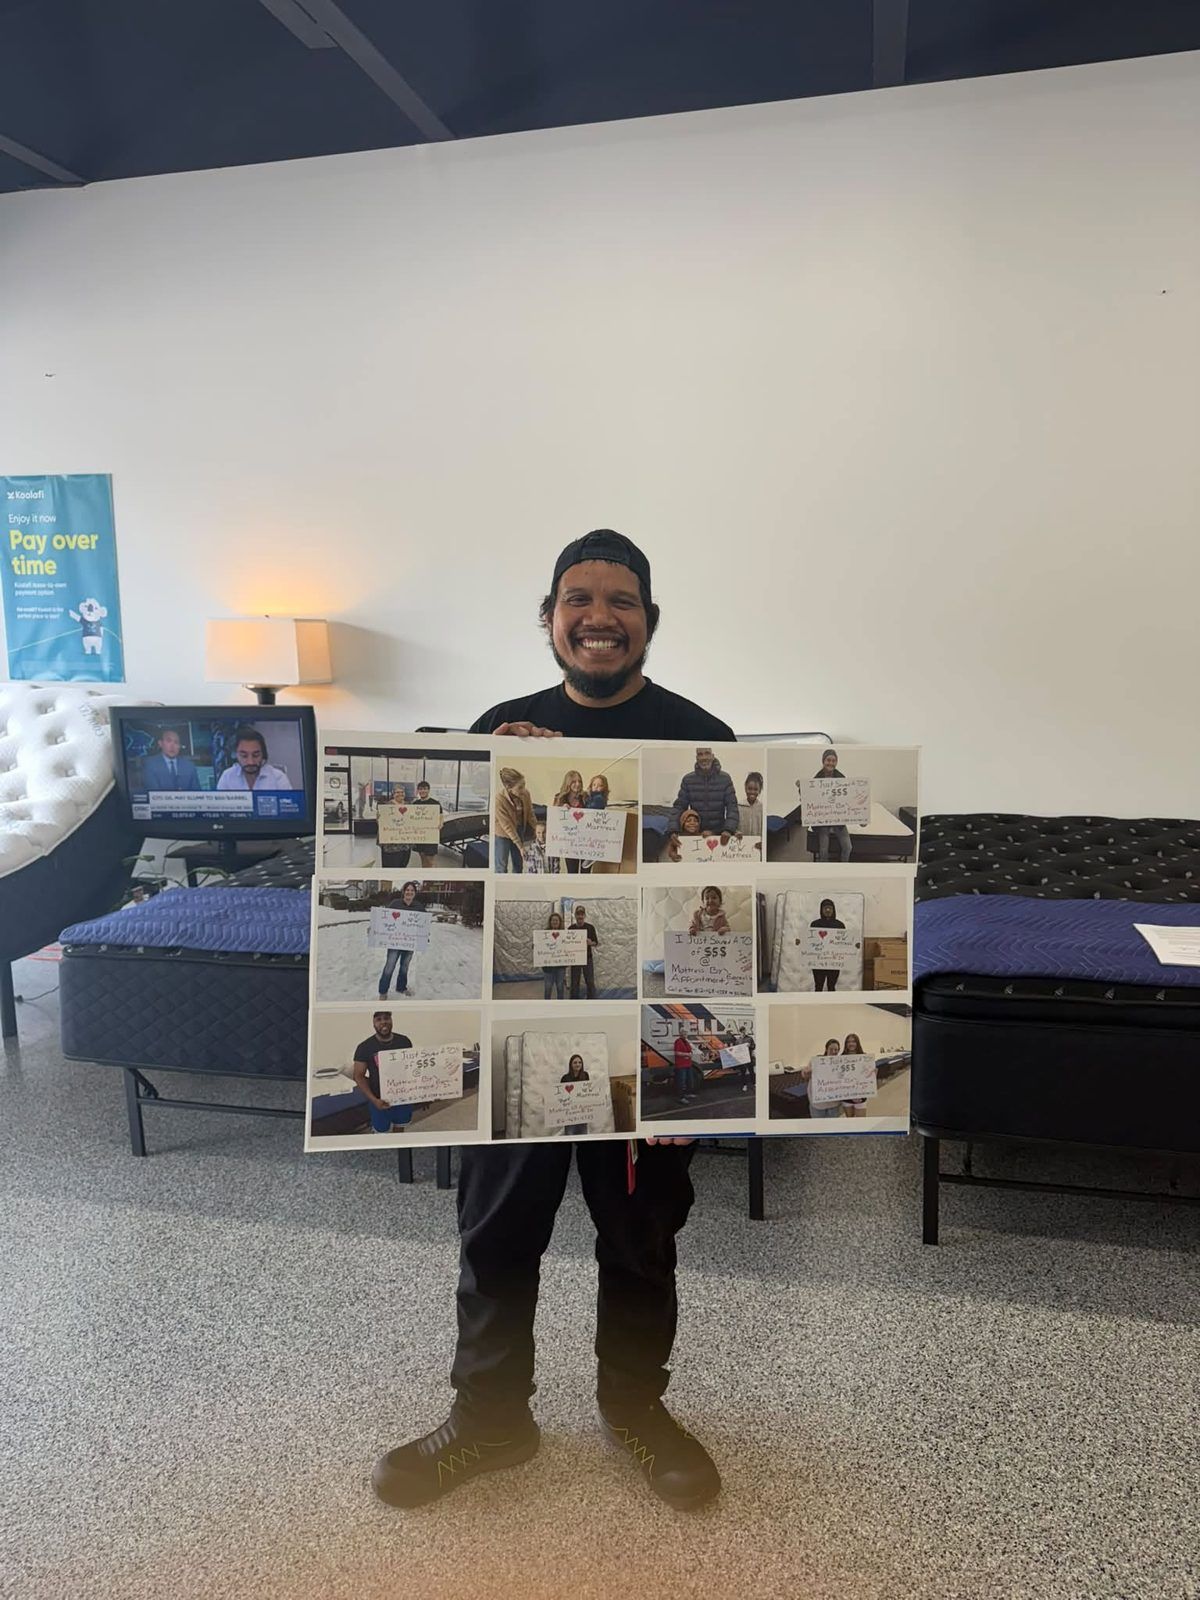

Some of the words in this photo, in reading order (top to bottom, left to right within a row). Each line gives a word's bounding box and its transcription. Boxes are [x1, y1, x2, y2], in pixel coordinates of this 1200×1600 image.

[8, 514, 31, 525] Enjoy
[32, 514, 38, 523] it
[40, 515, 56, 523] now
[9, 530, 48, 555] Pay
[52, 533, 99, 550] over
[11, 555, 57, 575] time
[809, 780, 815, 788] I
[819, 779, 833, 789] Just
[831, 788, 848, 797] $$$
[560, 810, 569, 821] I
[691, 839, 702, 852] I
[675, 933, 683, 944] I
[688, 933, 707, 945] Just
[808, 929, 816, 939] I
[691, 947, 702, 956] of
[704, 946, 727, 959] $$$
[699, 957, 711, 967] @
[672, 962, 705, 974] Mattress
[389, 1052, 397, 1061] I
[402, 1050, 419, 1060] Just
[416, 1057, 436, 1069] $$$
[840, 1064, 856, 1072] $$$
[553, 1085, 562, 1096] I
